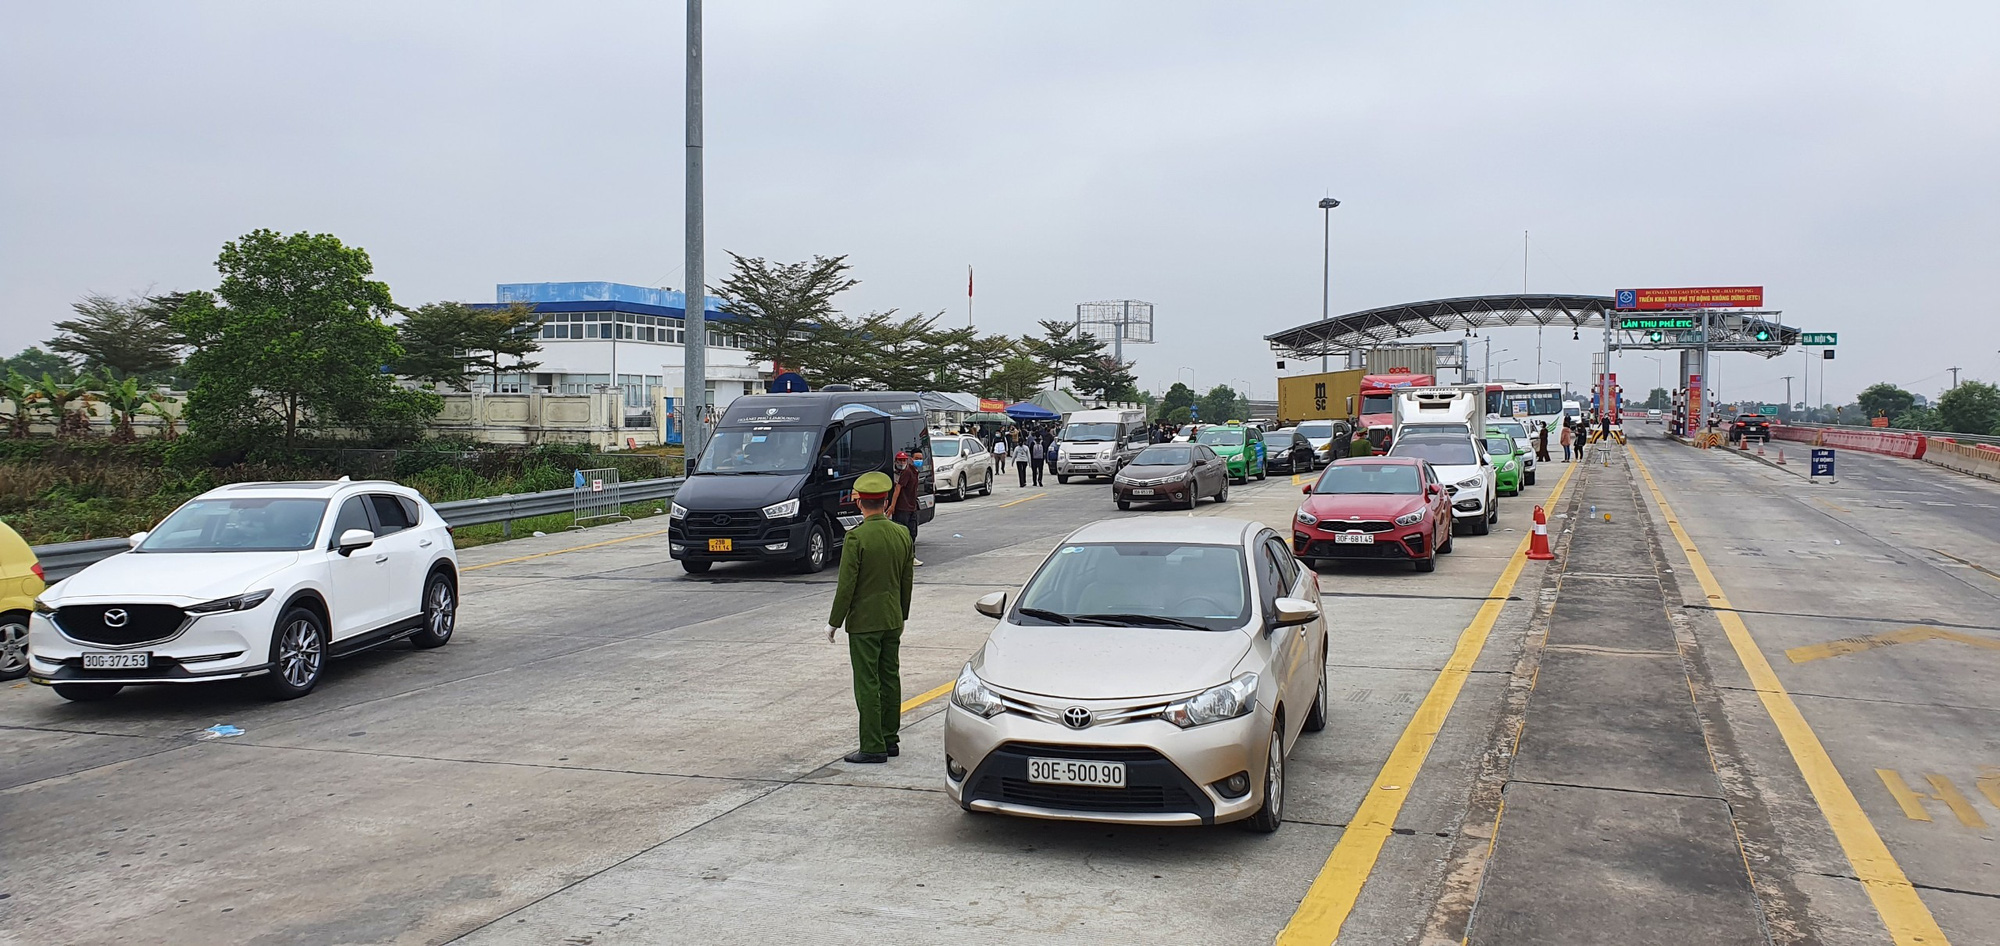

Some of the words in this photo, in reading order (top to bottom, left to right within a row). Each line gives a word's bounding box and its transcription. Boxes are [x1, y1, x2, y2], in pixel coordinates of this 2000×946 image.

[1622, 319, 1638, 328] LÀN
[1658, 318, 1675, 327] PHÍ
[1804, 334, 1812, 342] HÀ
[1814, 334, 1826, 344] NỘI
[696, 406, 702, 420] 7
[85, 654, 146, 667] 30G-372.53
[1031, 761, 1122, 784] 30E-500.90
